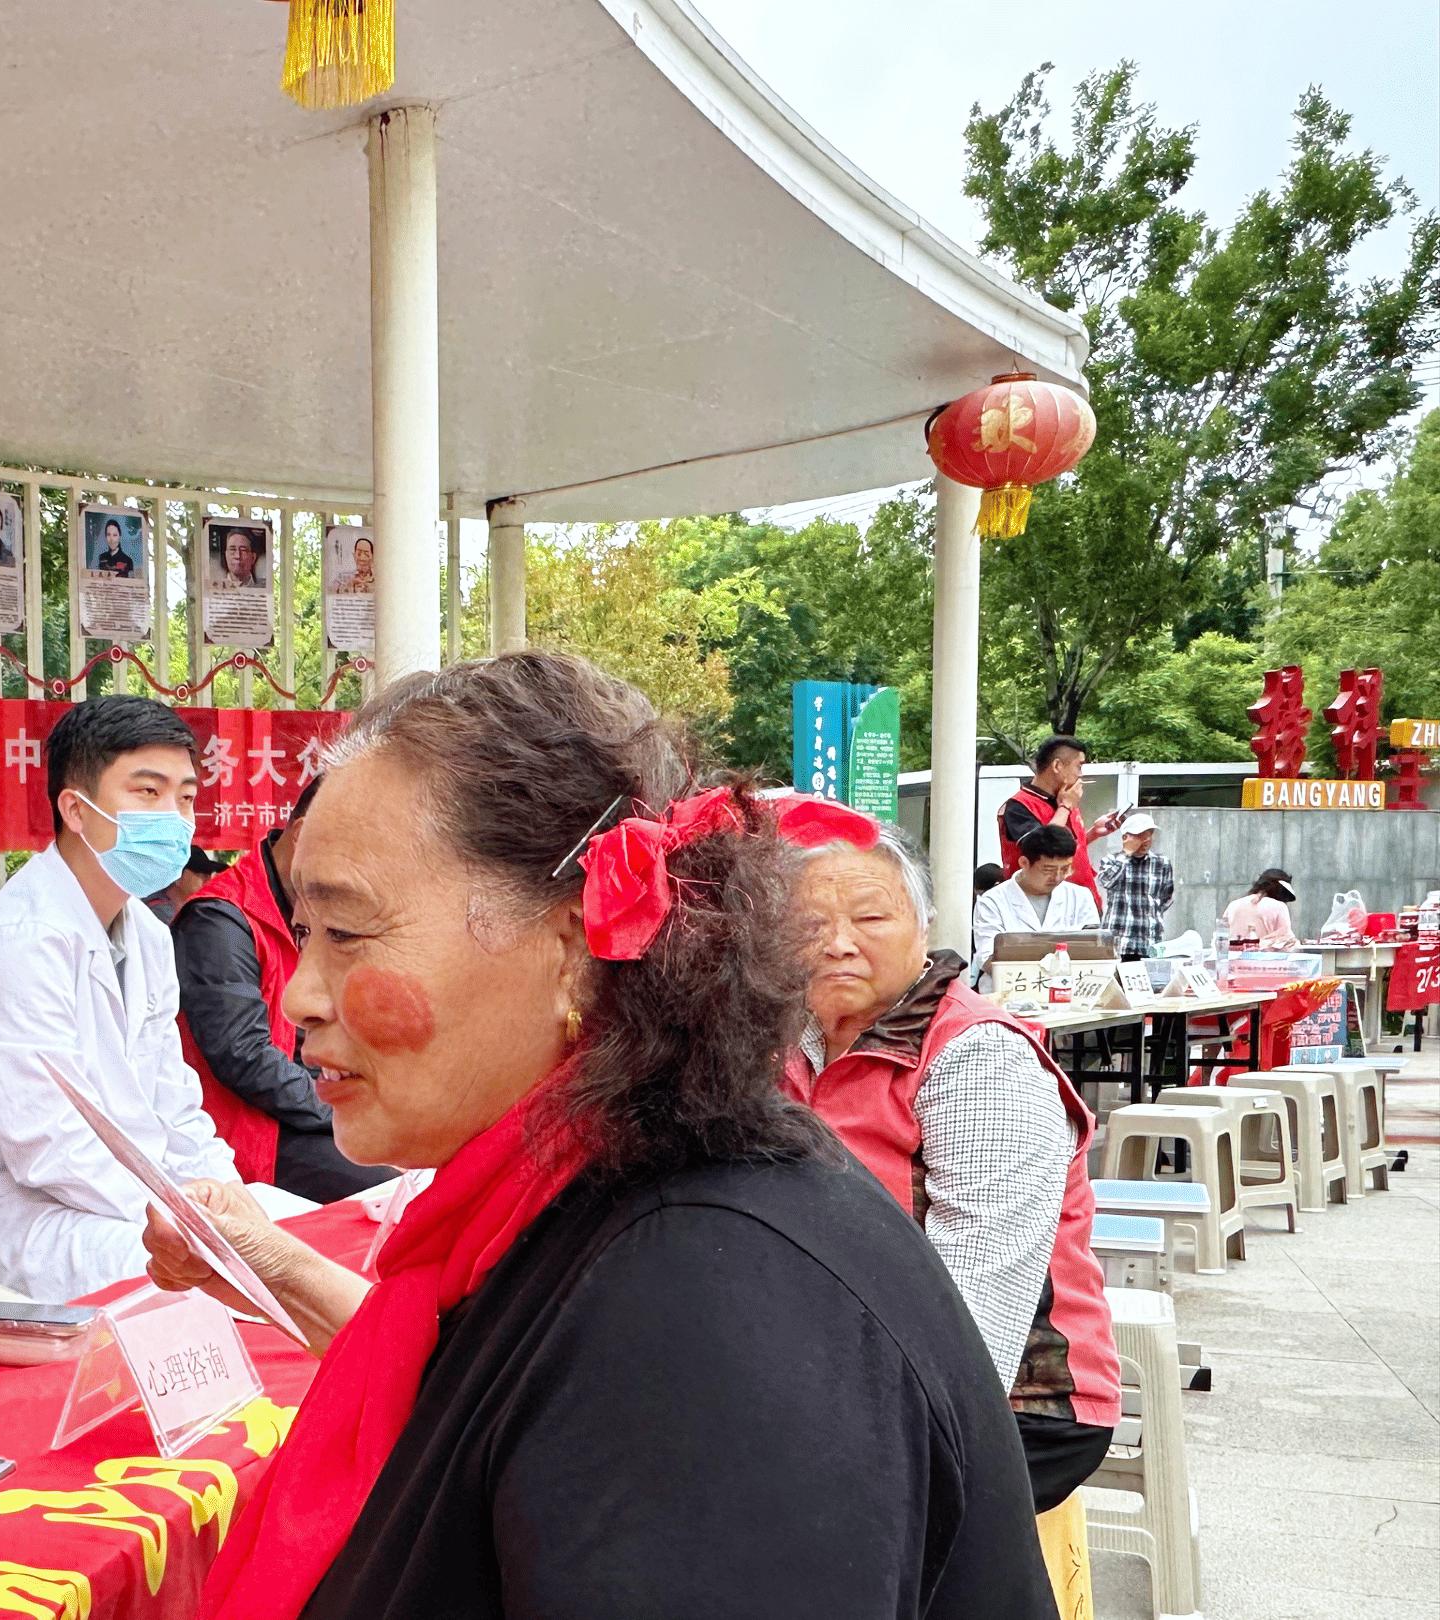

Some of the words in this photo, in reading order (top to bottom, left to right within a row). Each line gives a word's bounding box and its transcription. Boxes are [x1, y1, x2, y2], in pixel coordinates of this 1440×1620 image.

[1262, 781, 1381, 807] BANGYANG
[146, 1342, 231, 1397] 心理咨询
